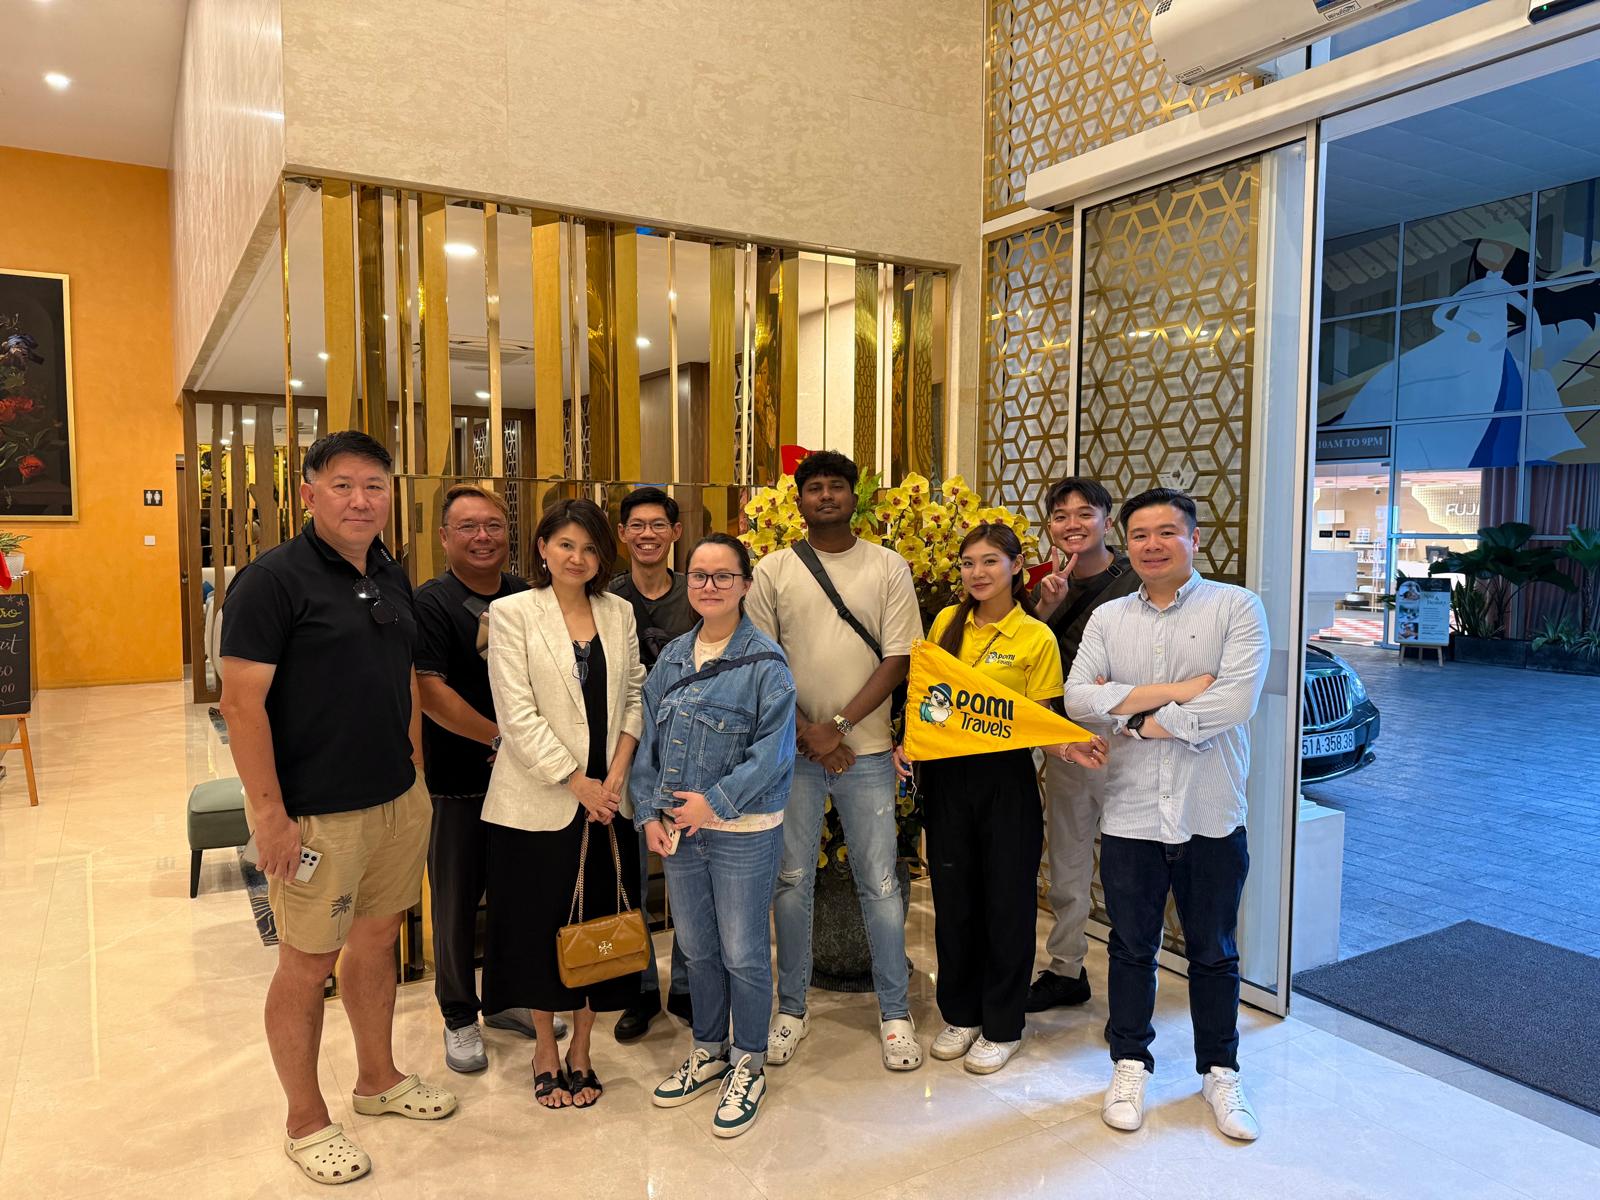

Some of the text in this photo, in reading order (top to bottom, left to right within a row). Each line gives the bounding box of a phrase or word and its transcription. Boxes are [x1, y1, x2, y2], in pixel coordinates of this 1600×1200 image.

[1318, 435, 1383, 449] 10AM TO 9PM
[960, 711, 1012, 739] Travels
[1302, 732, 1353, 756] 51A-358.38
